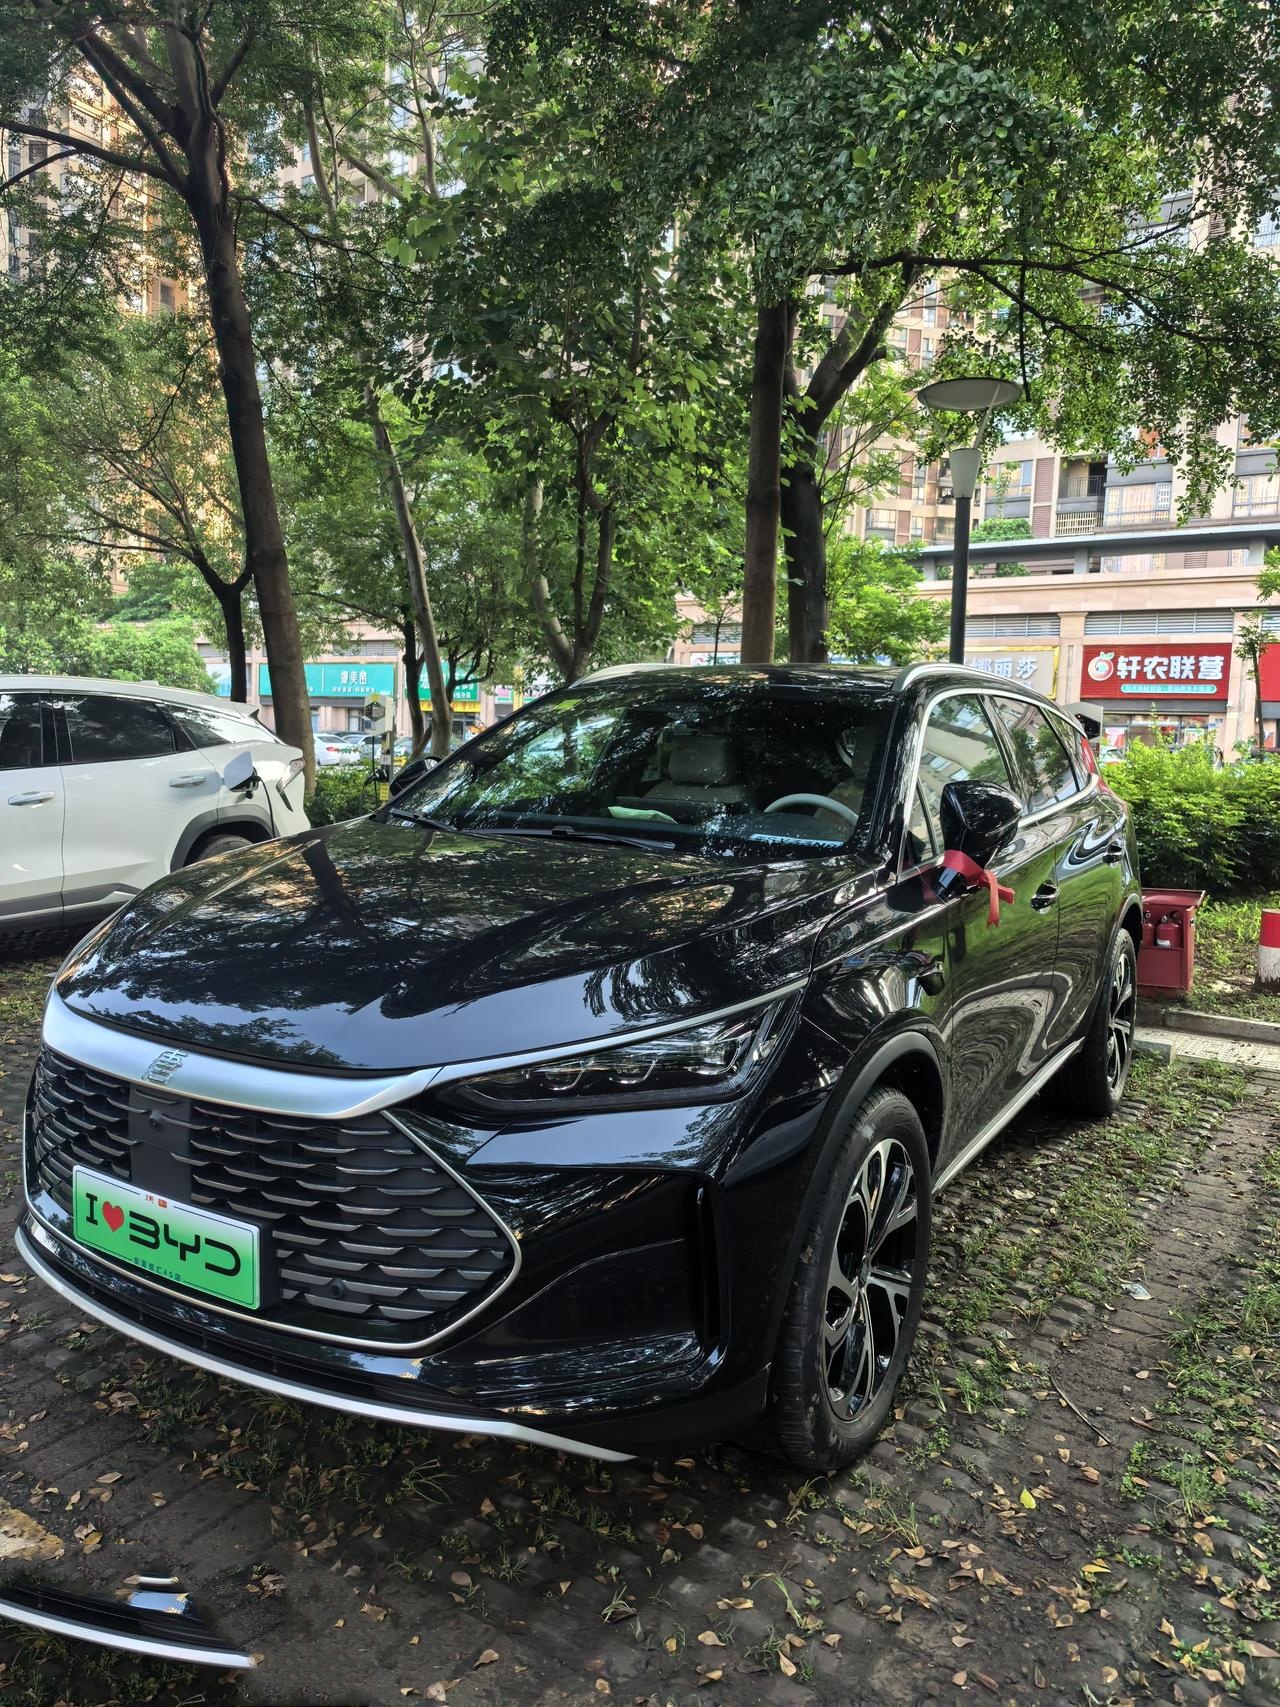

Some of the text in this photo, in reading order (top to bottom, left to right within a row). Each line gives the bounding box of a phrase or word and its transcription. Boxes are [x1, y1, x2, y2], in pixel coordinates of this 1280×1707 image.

[1117, 655, 1224, 680] 轩农联营
[85, 1192, 241, 1277] I BYD
